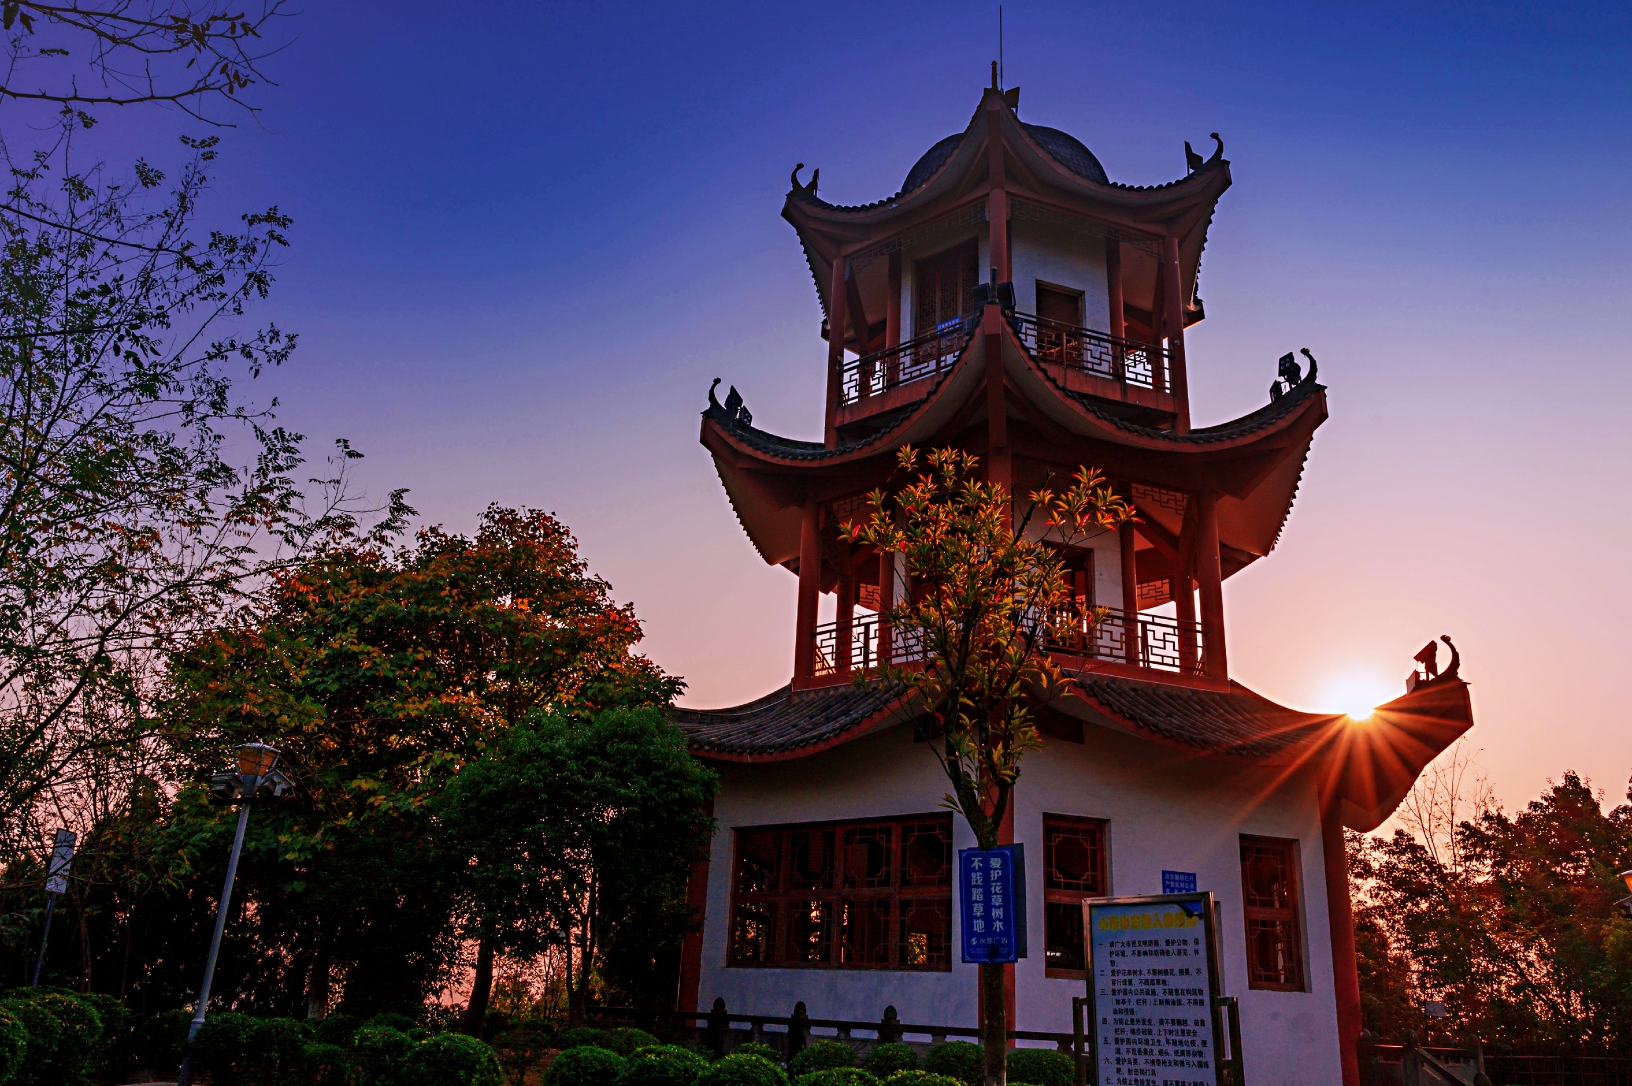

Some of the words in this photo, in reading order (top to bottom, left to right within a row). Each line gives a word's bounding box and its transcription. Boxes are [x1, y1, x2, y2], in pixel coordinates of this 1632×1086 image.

[971, 857, 985, 933] 不践踏草地
[990, 857, 1004, 932] 爱护花草树木
